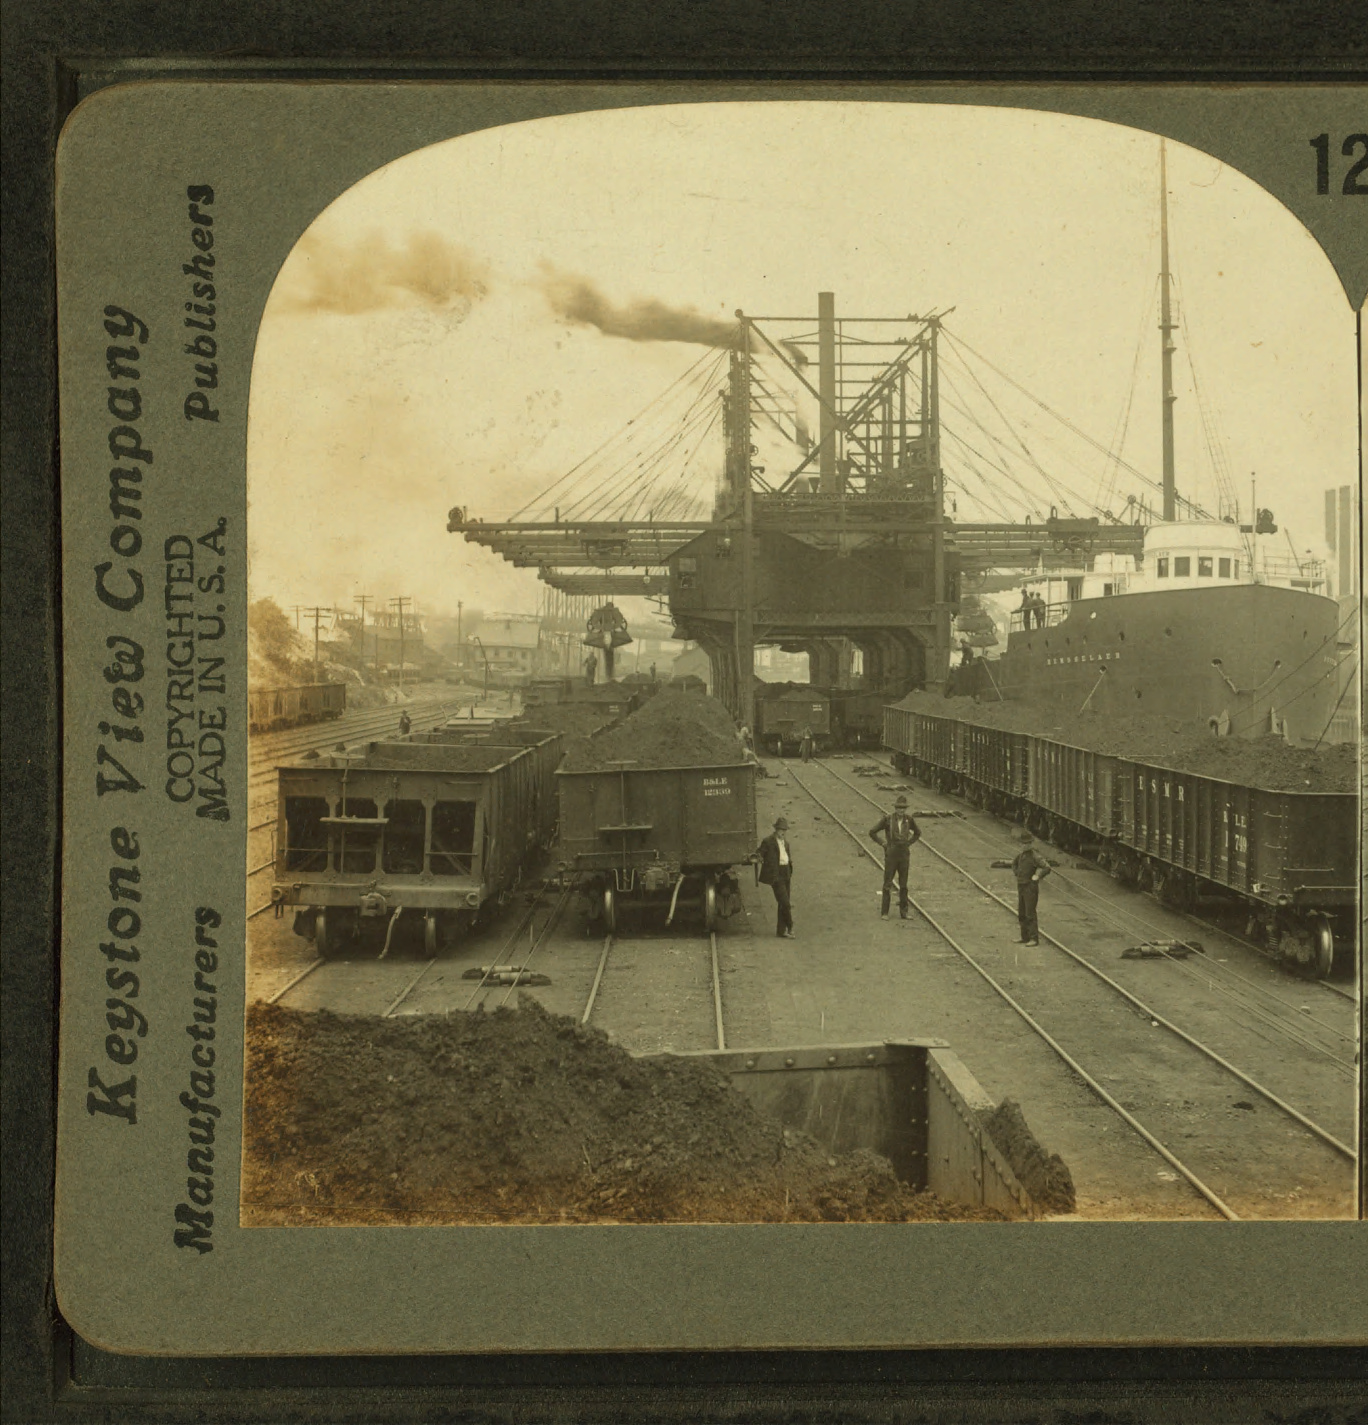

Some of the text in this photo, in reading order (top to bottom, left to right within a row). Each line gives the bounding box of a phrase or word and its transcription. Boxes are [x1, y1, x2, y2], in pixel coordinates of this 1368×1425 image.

[86, 304, 154, 1125] Keystone View Company
[164, 534, 195, 803] COPYRIGHTED
[173, 184, 222, 1255] Manufacturers Publishers
[196, 516, 231, 822] MADE IN U. S. A.
